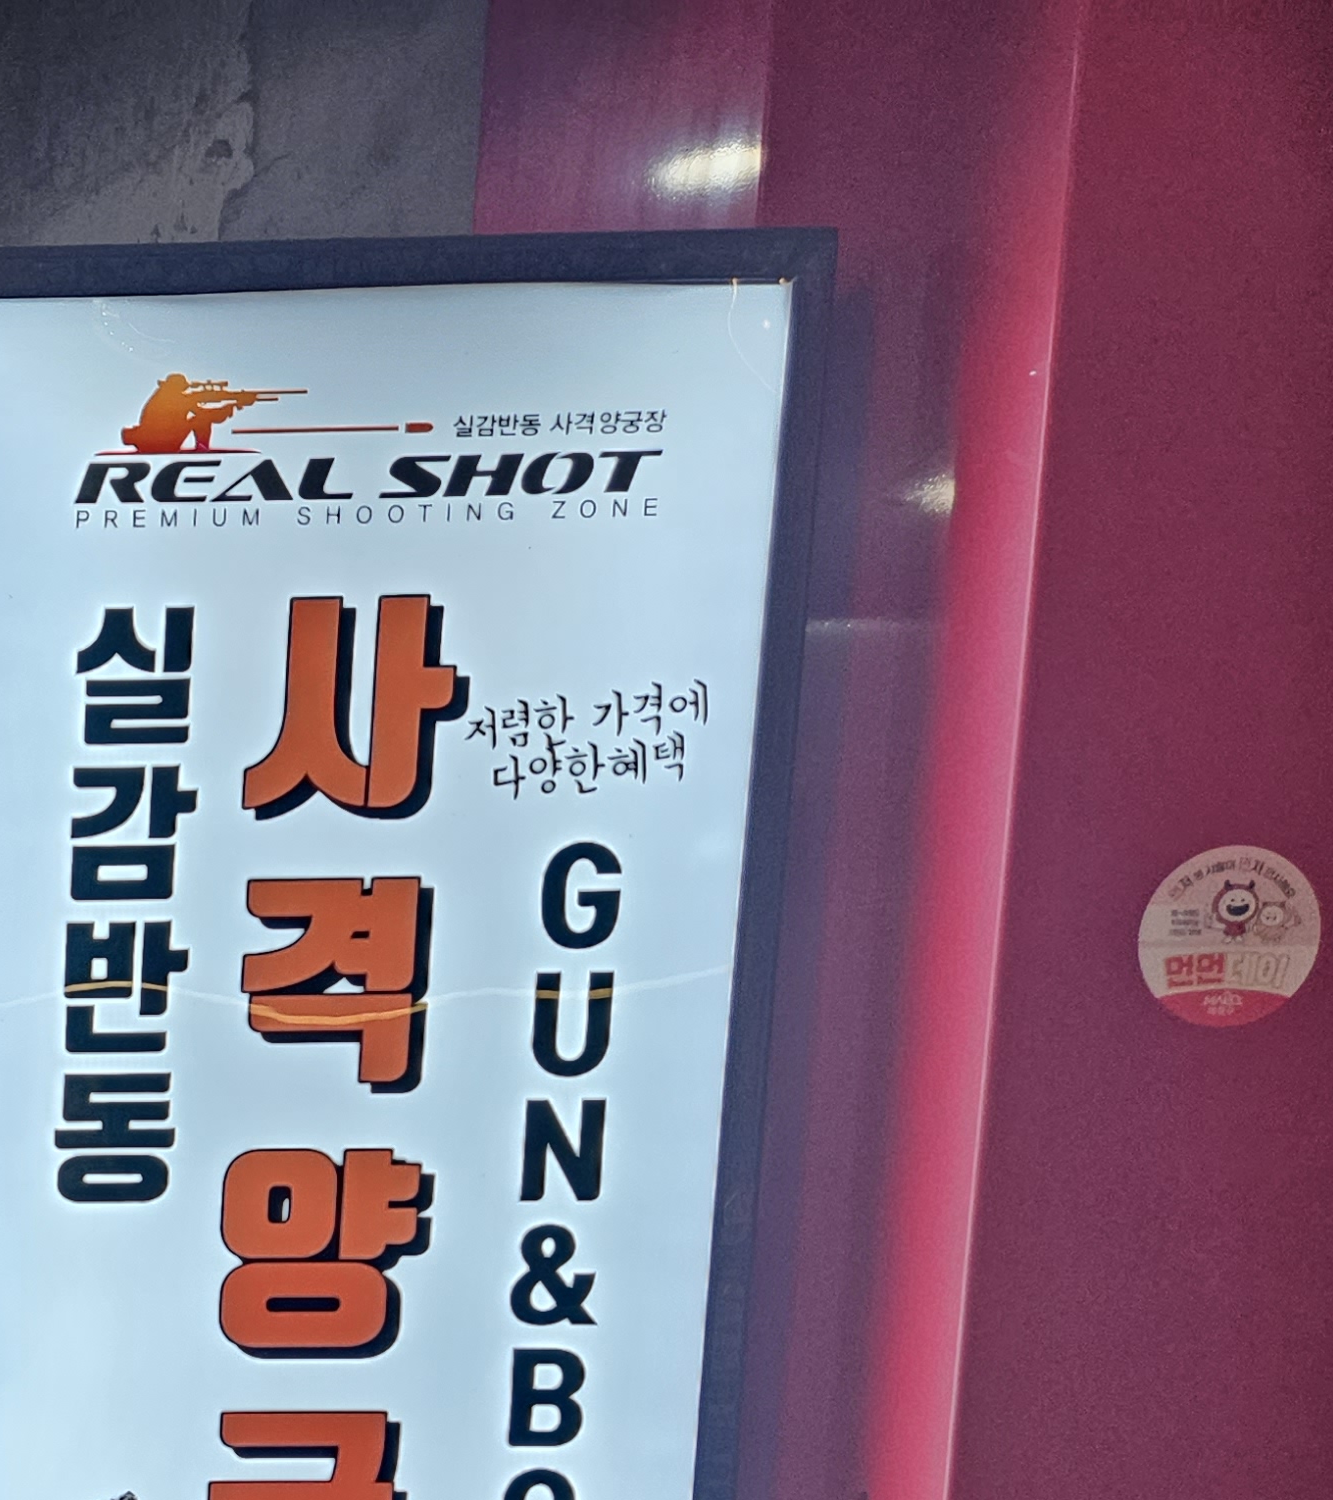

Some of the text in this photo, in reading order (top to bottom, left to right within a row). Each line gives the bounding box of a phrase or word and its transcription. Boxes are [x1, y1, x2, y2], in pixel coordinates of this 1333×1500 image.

[453, 415, 542, 438] 실감반동
[74, 450, 664, 504] REAL SHOT
[75, 498, 660, 529] PREMIUM SHOOTING ZONE
[464, 678, 709, 750] 저렴한 가격에
[54, 605, 198, 1203] 실감반동
